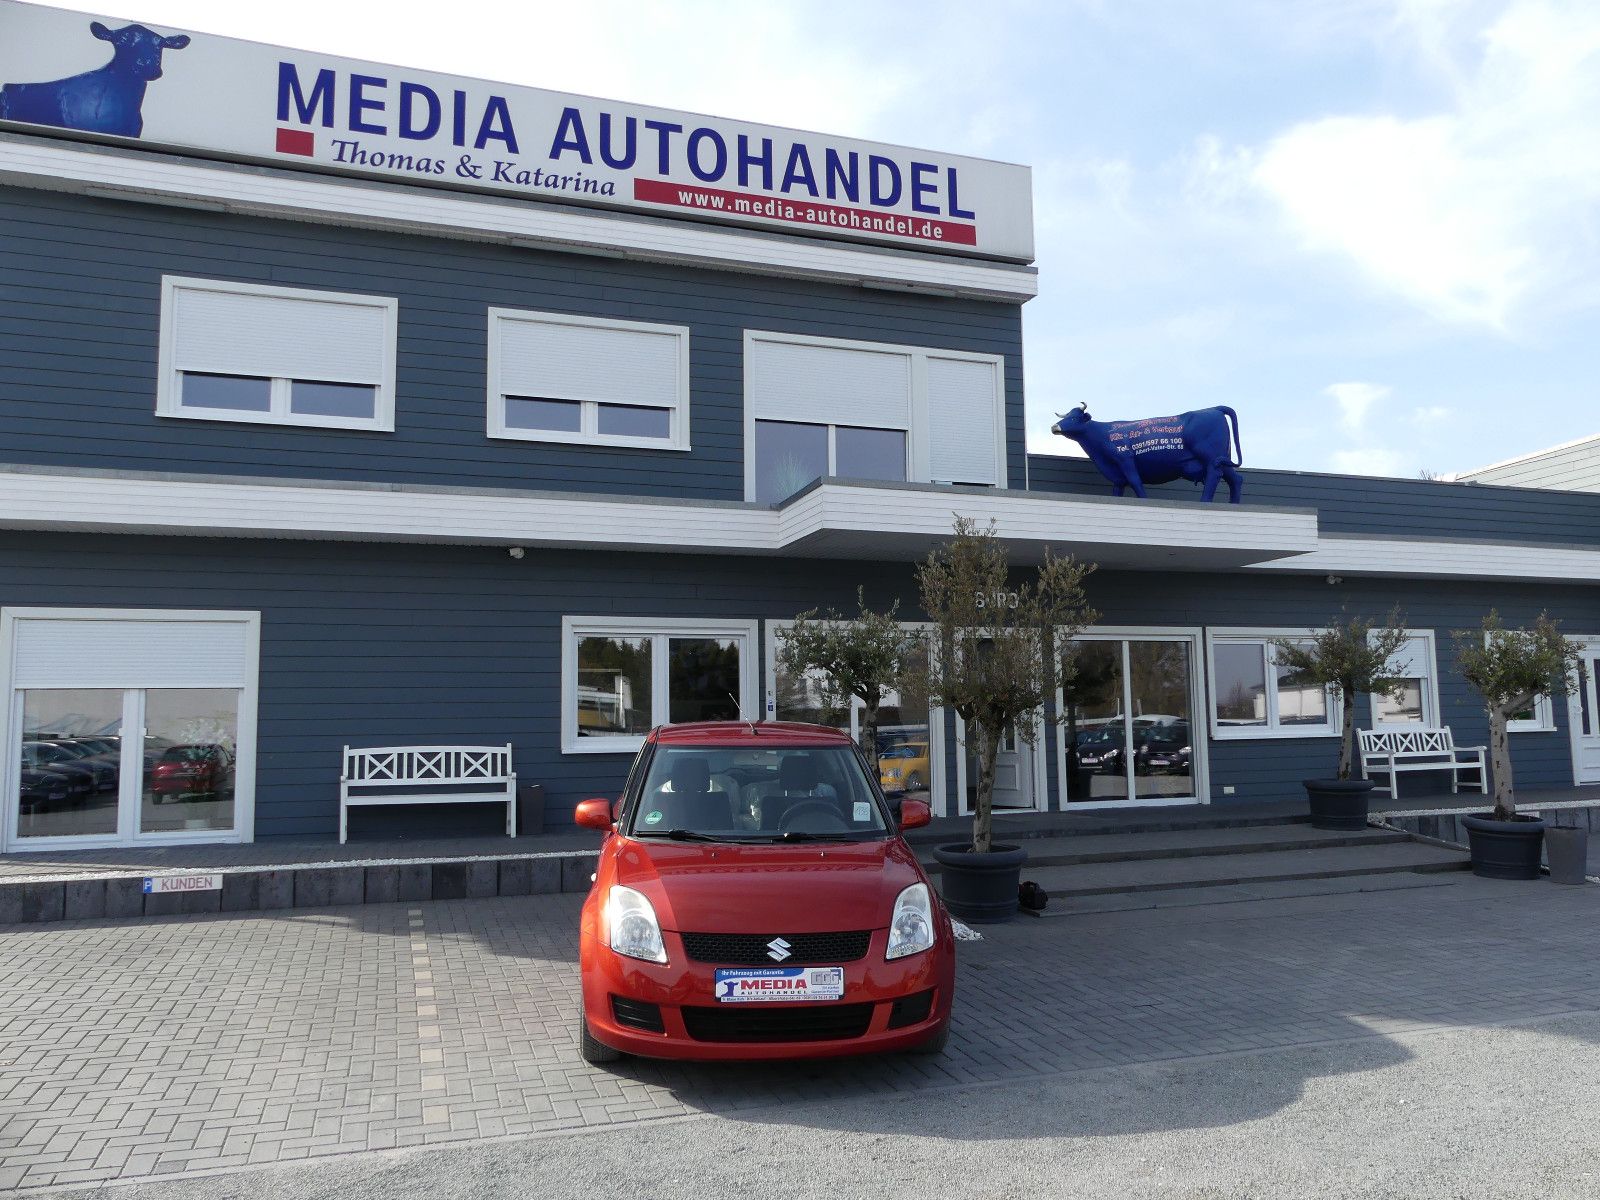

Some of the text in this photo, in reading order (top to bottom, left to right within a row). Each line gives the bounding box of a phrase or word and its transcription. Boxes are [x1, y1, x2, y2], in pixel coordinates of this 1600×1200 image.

[276, 61, 976, 221] MEDIA AUTOHANDEL
[330, 138, 617, 197] Thomas & Katarina
[677, 188, 944, 240] www.media-autohandel.de
[144, 877, 213, 890] P KUNDEN
[740, 978, 807, 989] MEDIA
